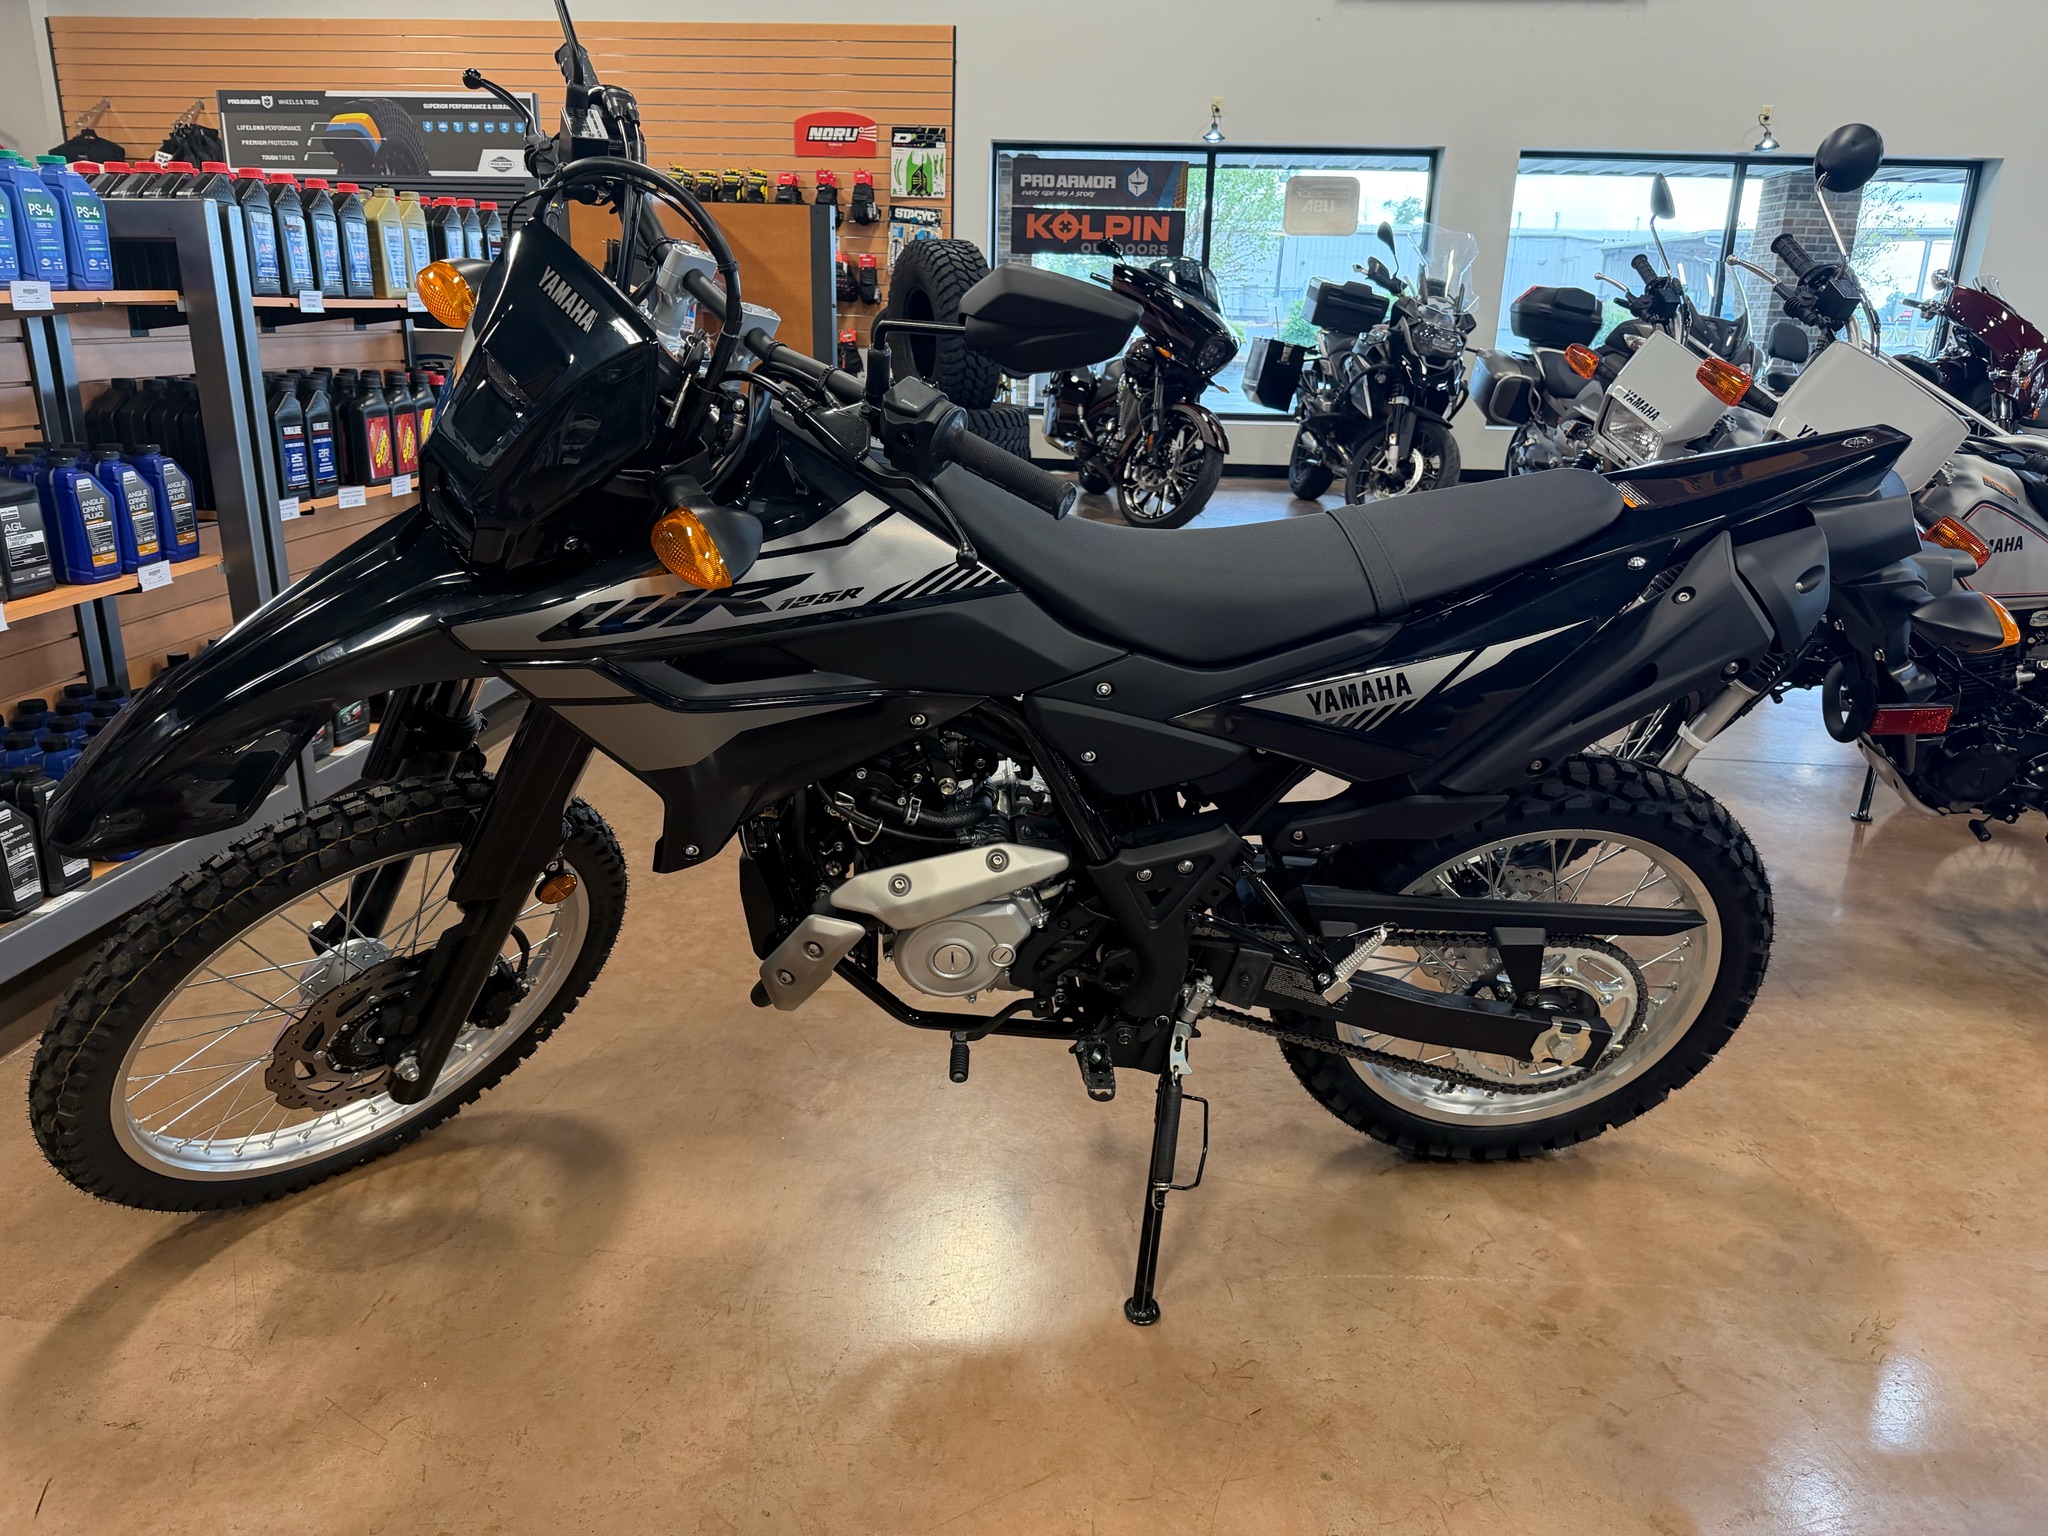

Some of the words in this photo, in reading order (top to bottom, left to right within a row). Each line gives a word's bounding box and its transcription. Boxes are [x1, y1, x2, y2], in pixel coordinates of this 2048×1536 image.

[808, 127, 859, 141] NORU
[28, 203, 54, 217] PS-4
[76, 206, 100, 219] PS-4
[1026, 211, 1170, 243] KOLPIN
[538, 265, 597, 332] YAMAHA
[1623, 389, 1660, 421] YAMAHA
[166, 481, 187, 489] ANGLE
[127, 489, 148, 499] ANGLE
[167, 487, 185, 496] DRIVE
[81, 497, 106, 507] ANGLE
[128, 496, 147, 505] DRIVE
[169, 494, 186, 502] FLUID
[82, 504, 104, 514] DRIVE
[129, 503, 148, 512] FLUID
[83, 511, 104, 521] FLUID
[4, 521, 26, 533] AGL
[776, 587, 864, 611] 125R
[1306, 672, 1412, 715] YAMAHA
